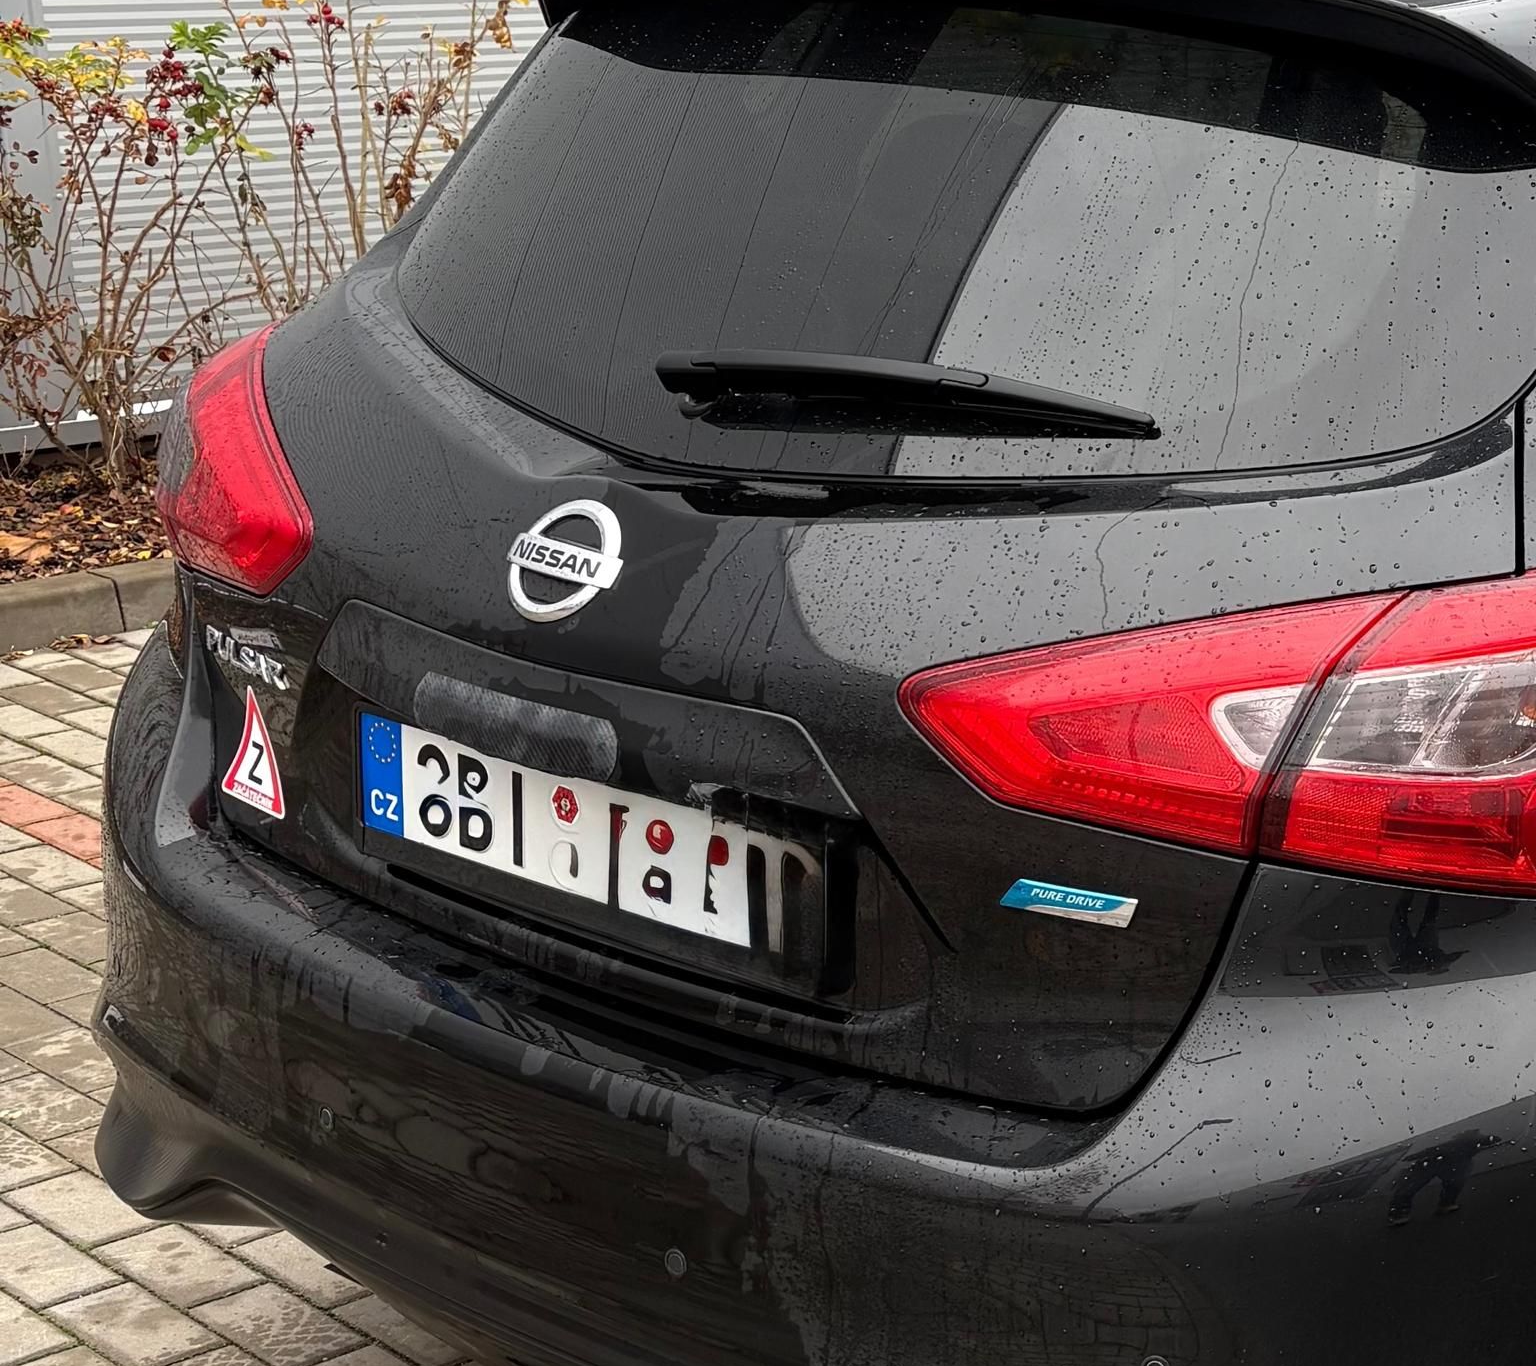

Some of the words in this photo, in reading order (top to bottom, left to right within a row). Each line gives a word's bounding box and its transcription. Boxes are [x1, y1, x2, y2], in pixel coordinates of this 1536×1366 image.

[512, 538, 602, 579] NISSAN
[206, 624, 291, 691] PULSAR
[247, 740, 264, 786] Z
[370, 788, 399, 822] CZ
[1030, 887, 1064, 903] PURE
[1065, 894, 1106, 910] DRIVE
